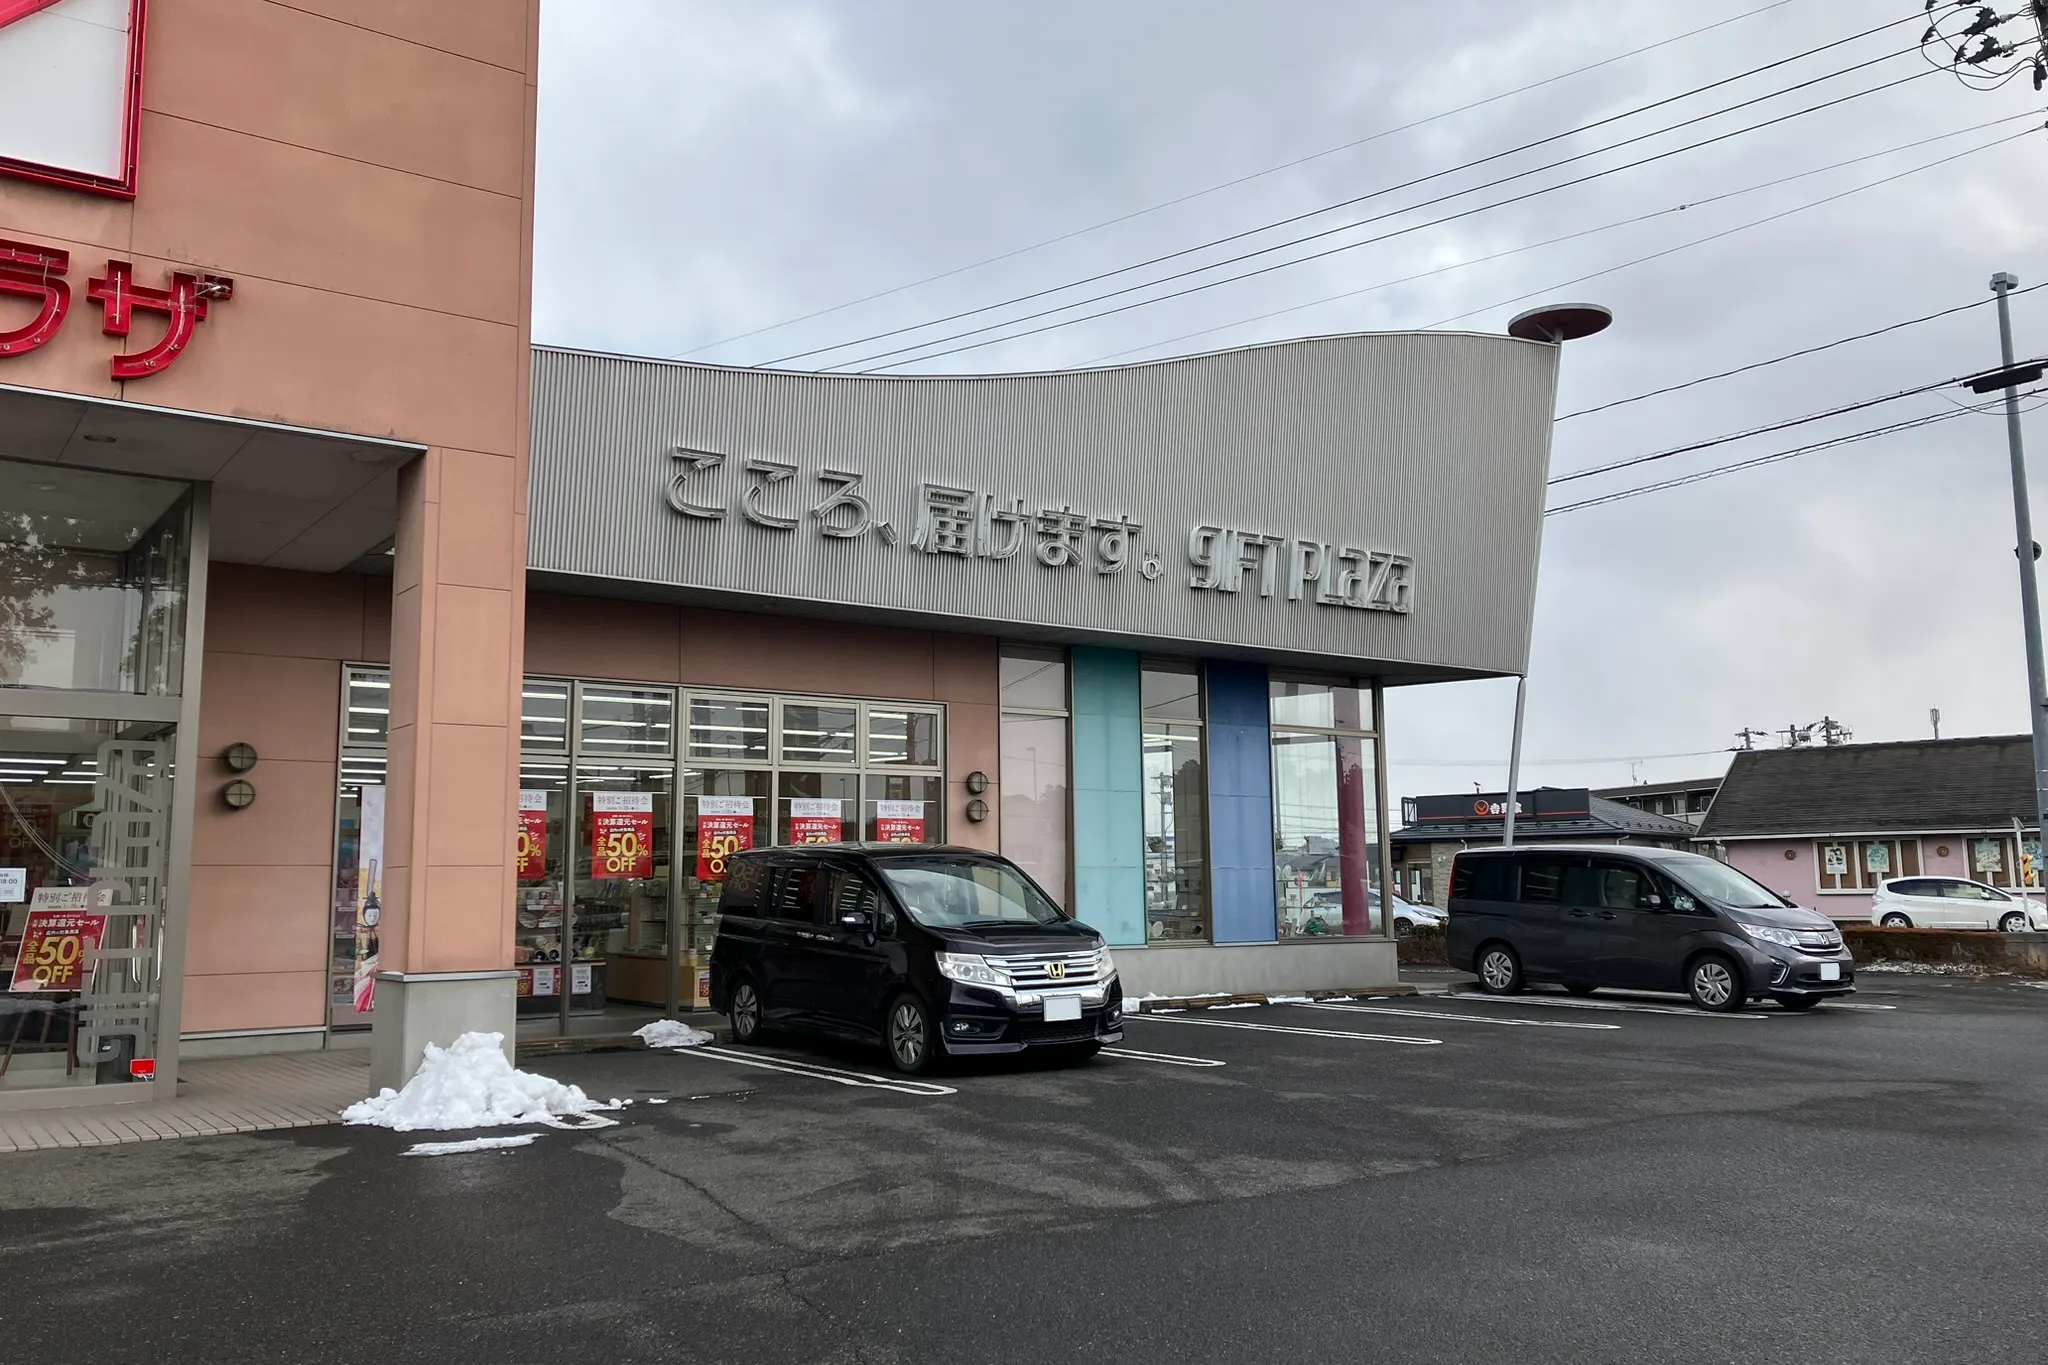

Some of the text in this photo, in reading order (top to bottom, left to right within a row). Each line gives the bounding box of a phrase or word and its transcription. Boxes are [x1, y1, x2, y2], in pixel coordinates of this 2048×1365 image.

[666, 446, 1163, 580] こころ、届けます。
[606, 833, 649, 857] 50%
[710, 835, 747, 859] 50
[606, 858, 637, 873] OFF
[38, 918, 100, 928] 決算還元セール
[22, 940, 39, 965] 全品
[32, 965, 73, 984] OFF
